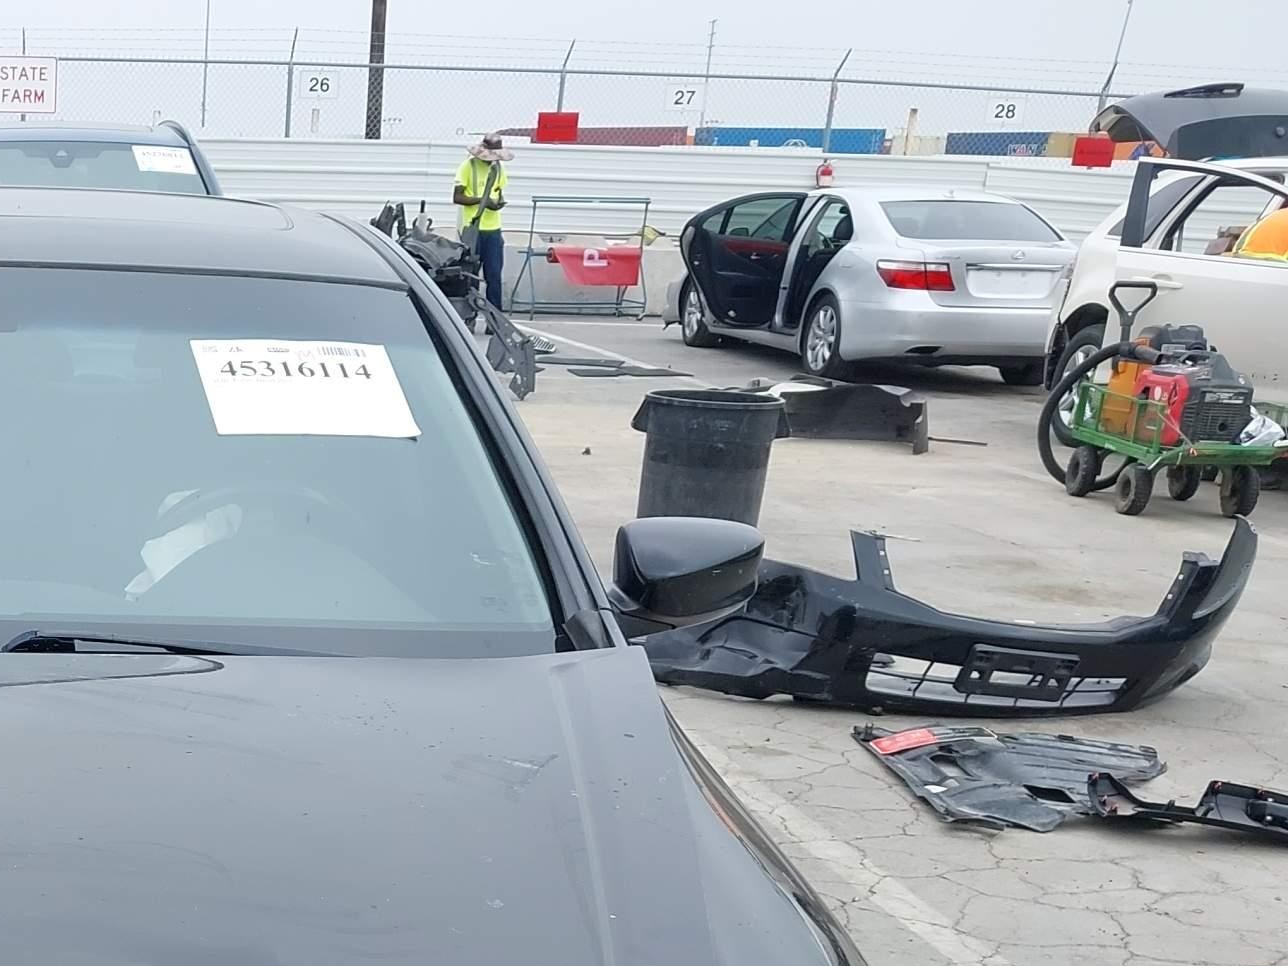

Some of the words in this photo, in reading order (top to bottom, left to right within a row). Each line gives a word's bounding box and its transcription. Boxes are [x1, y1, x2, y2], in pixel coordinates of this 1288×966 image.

[0, 66, 49, 82] STATE
[309, 77, 330, 93] 26
[1, 88, 45, 104] FARM
[673, 89, 696, 105] 27
[994, 103, 1016, 119] 28
[220, 360, 372, 380] 45316114
